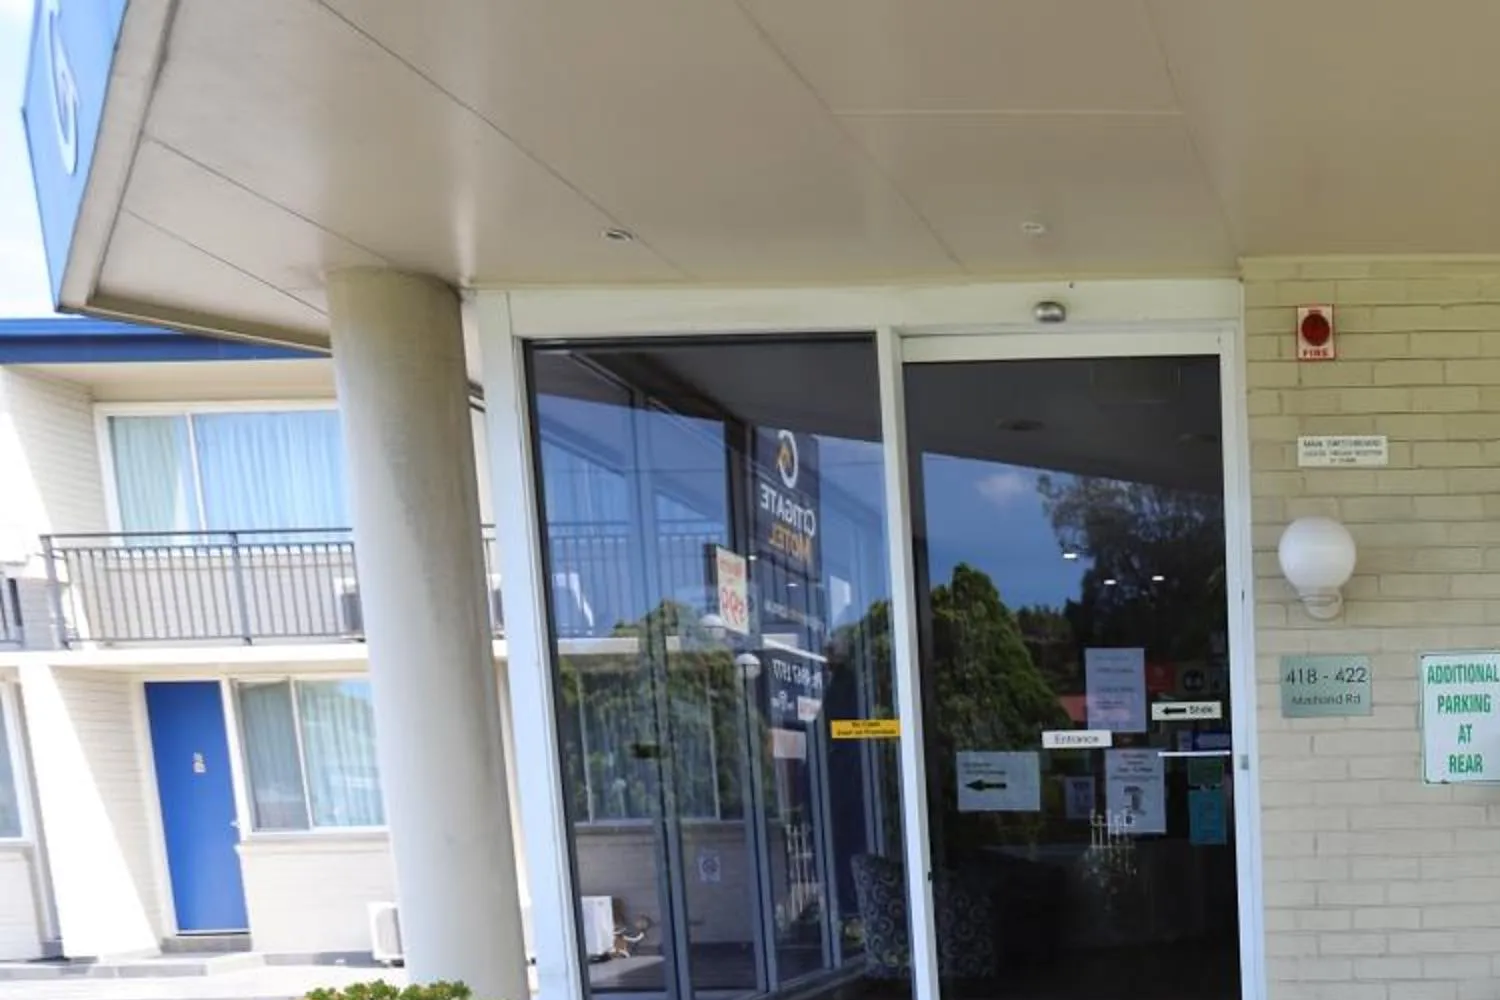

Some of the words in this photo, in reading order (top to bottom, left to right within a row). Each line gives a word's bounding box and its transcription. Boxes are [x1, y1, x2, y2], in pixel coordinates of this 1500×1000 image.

[1286, 669, 1317, 685] 418
[1334, 667, 1367, 683] 422
[1427, 663, 1500, 685] ADDITIONAL
[1437, 694, 1491, 714] PARKING
[1458, 724, 1472, 744] AT
[1449, 754, 1483, 774] REAR
